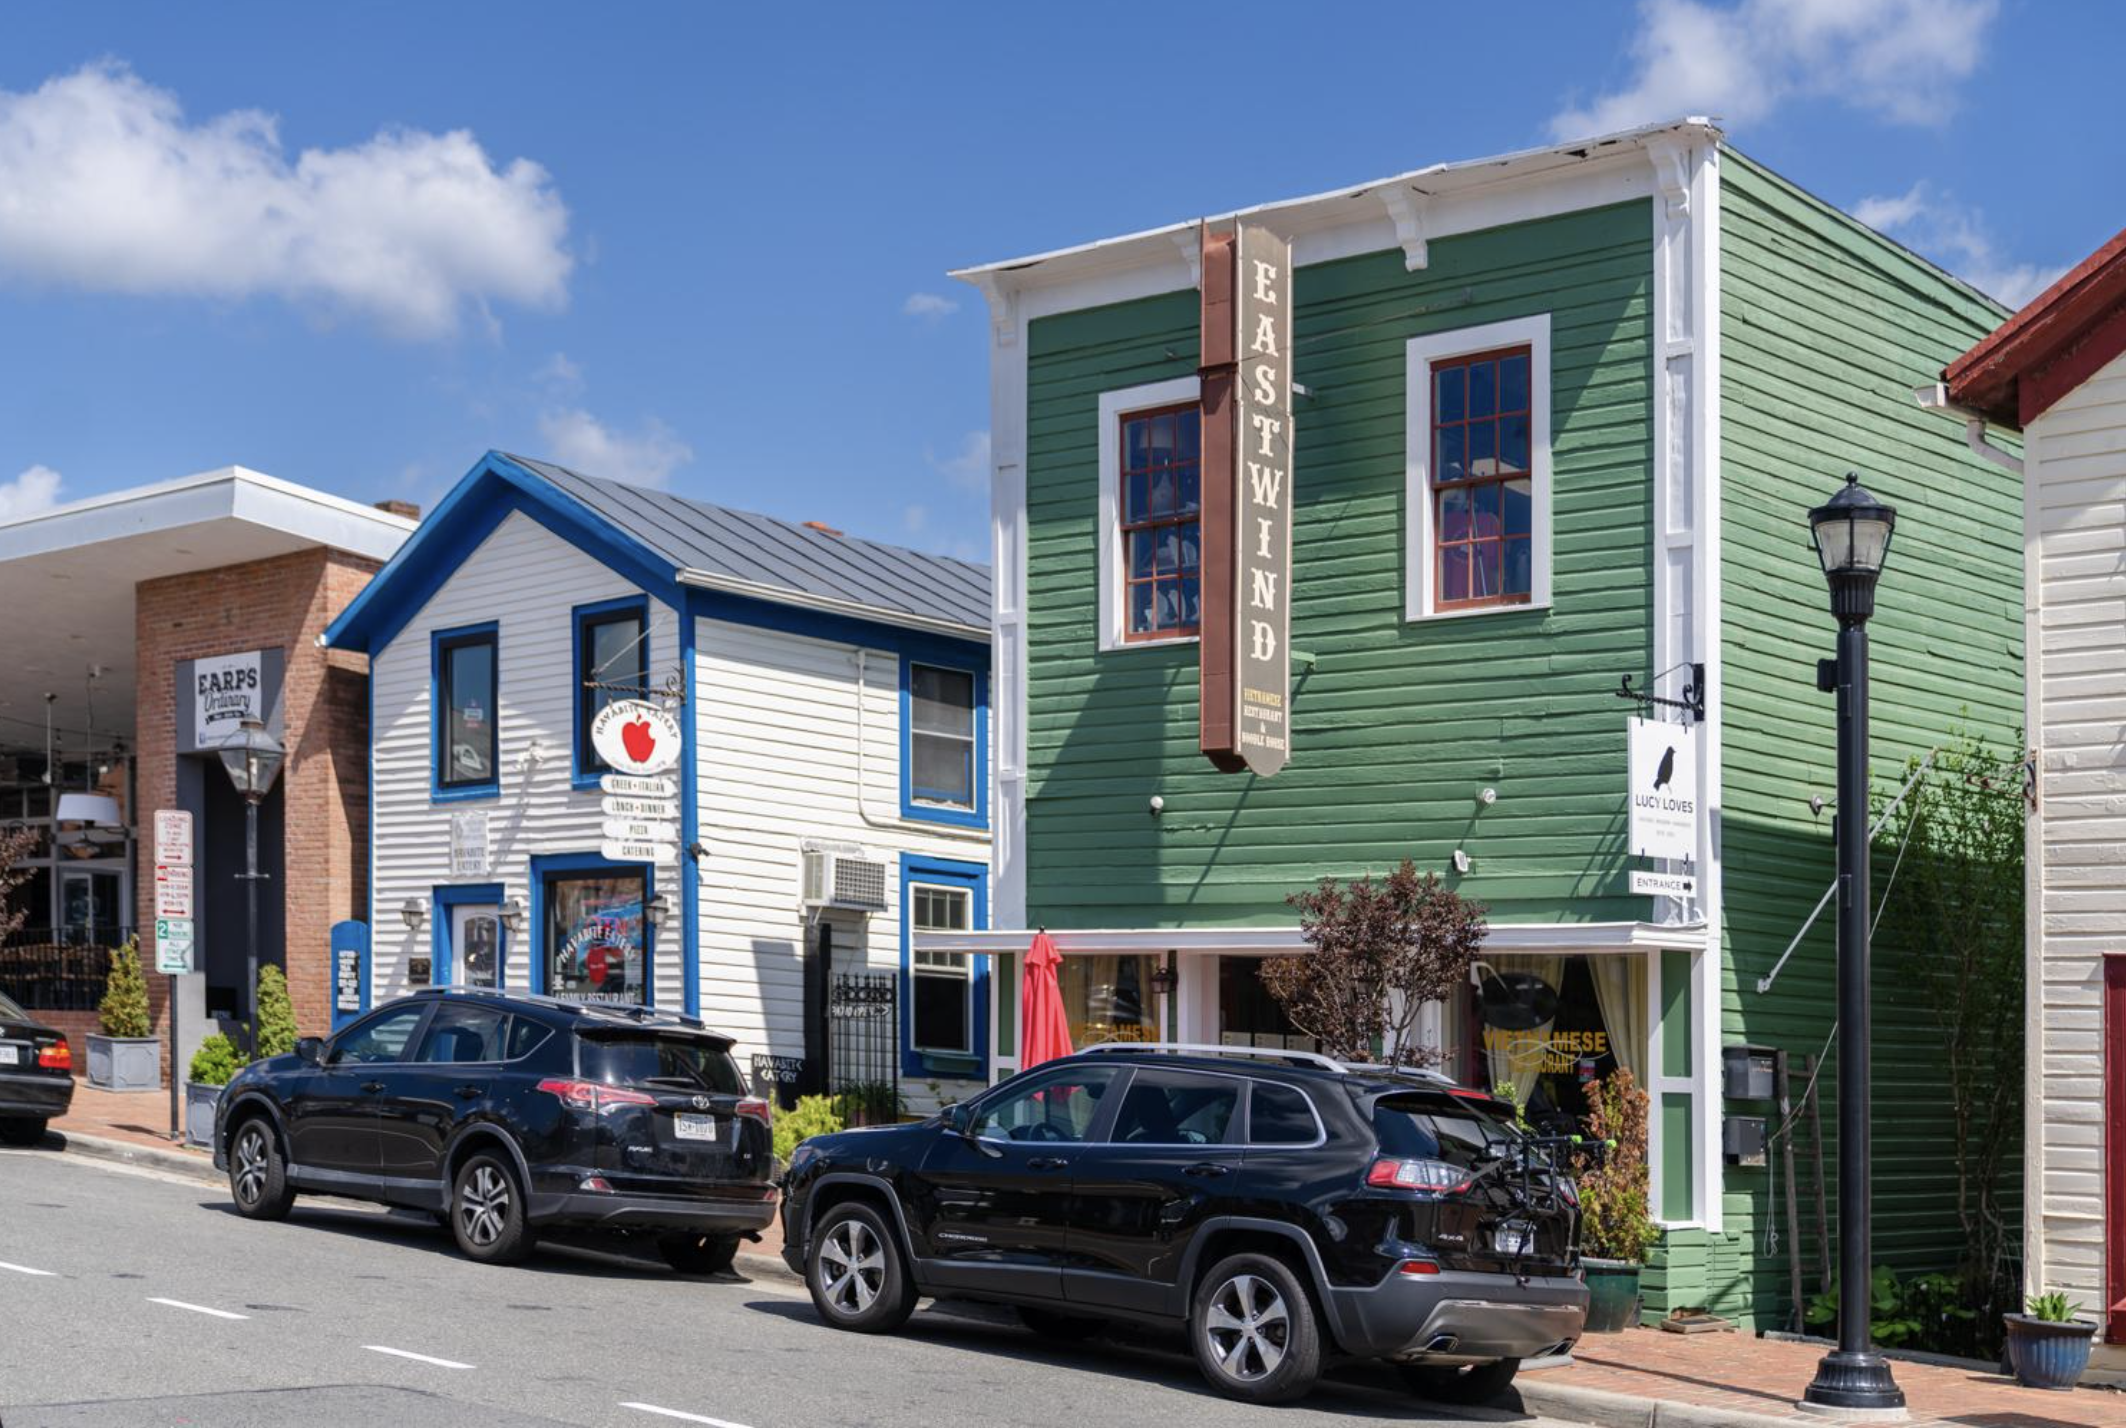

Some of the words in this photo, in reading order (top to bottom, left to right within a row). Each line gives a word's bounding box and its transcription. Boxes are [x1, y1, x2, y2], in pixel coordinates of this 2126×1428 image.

[1247, 258, 1285, 662] EASTWIND
[1243, 687, 1282, 708] VIETNAMESE
[1243, 704, 1283, 724] RESTAURANT
[1241, 731, 1265, 746] NOODLE
[1265, 736, 1286, 751] HOUSE
[611, 779, 632, 790] GREEK
[612, 801, 634, 812] LUNCH
[1635, 794, 1662, 809] LUCY
[1663, 798, 1694, 814] LOVES
[629, 825, 648, 836] PIZZA
[622, 846, 655, 858] CATERING
[1637, 877, 1682, 891] ENTRANCE
[159, 923, 166, 936] 2
